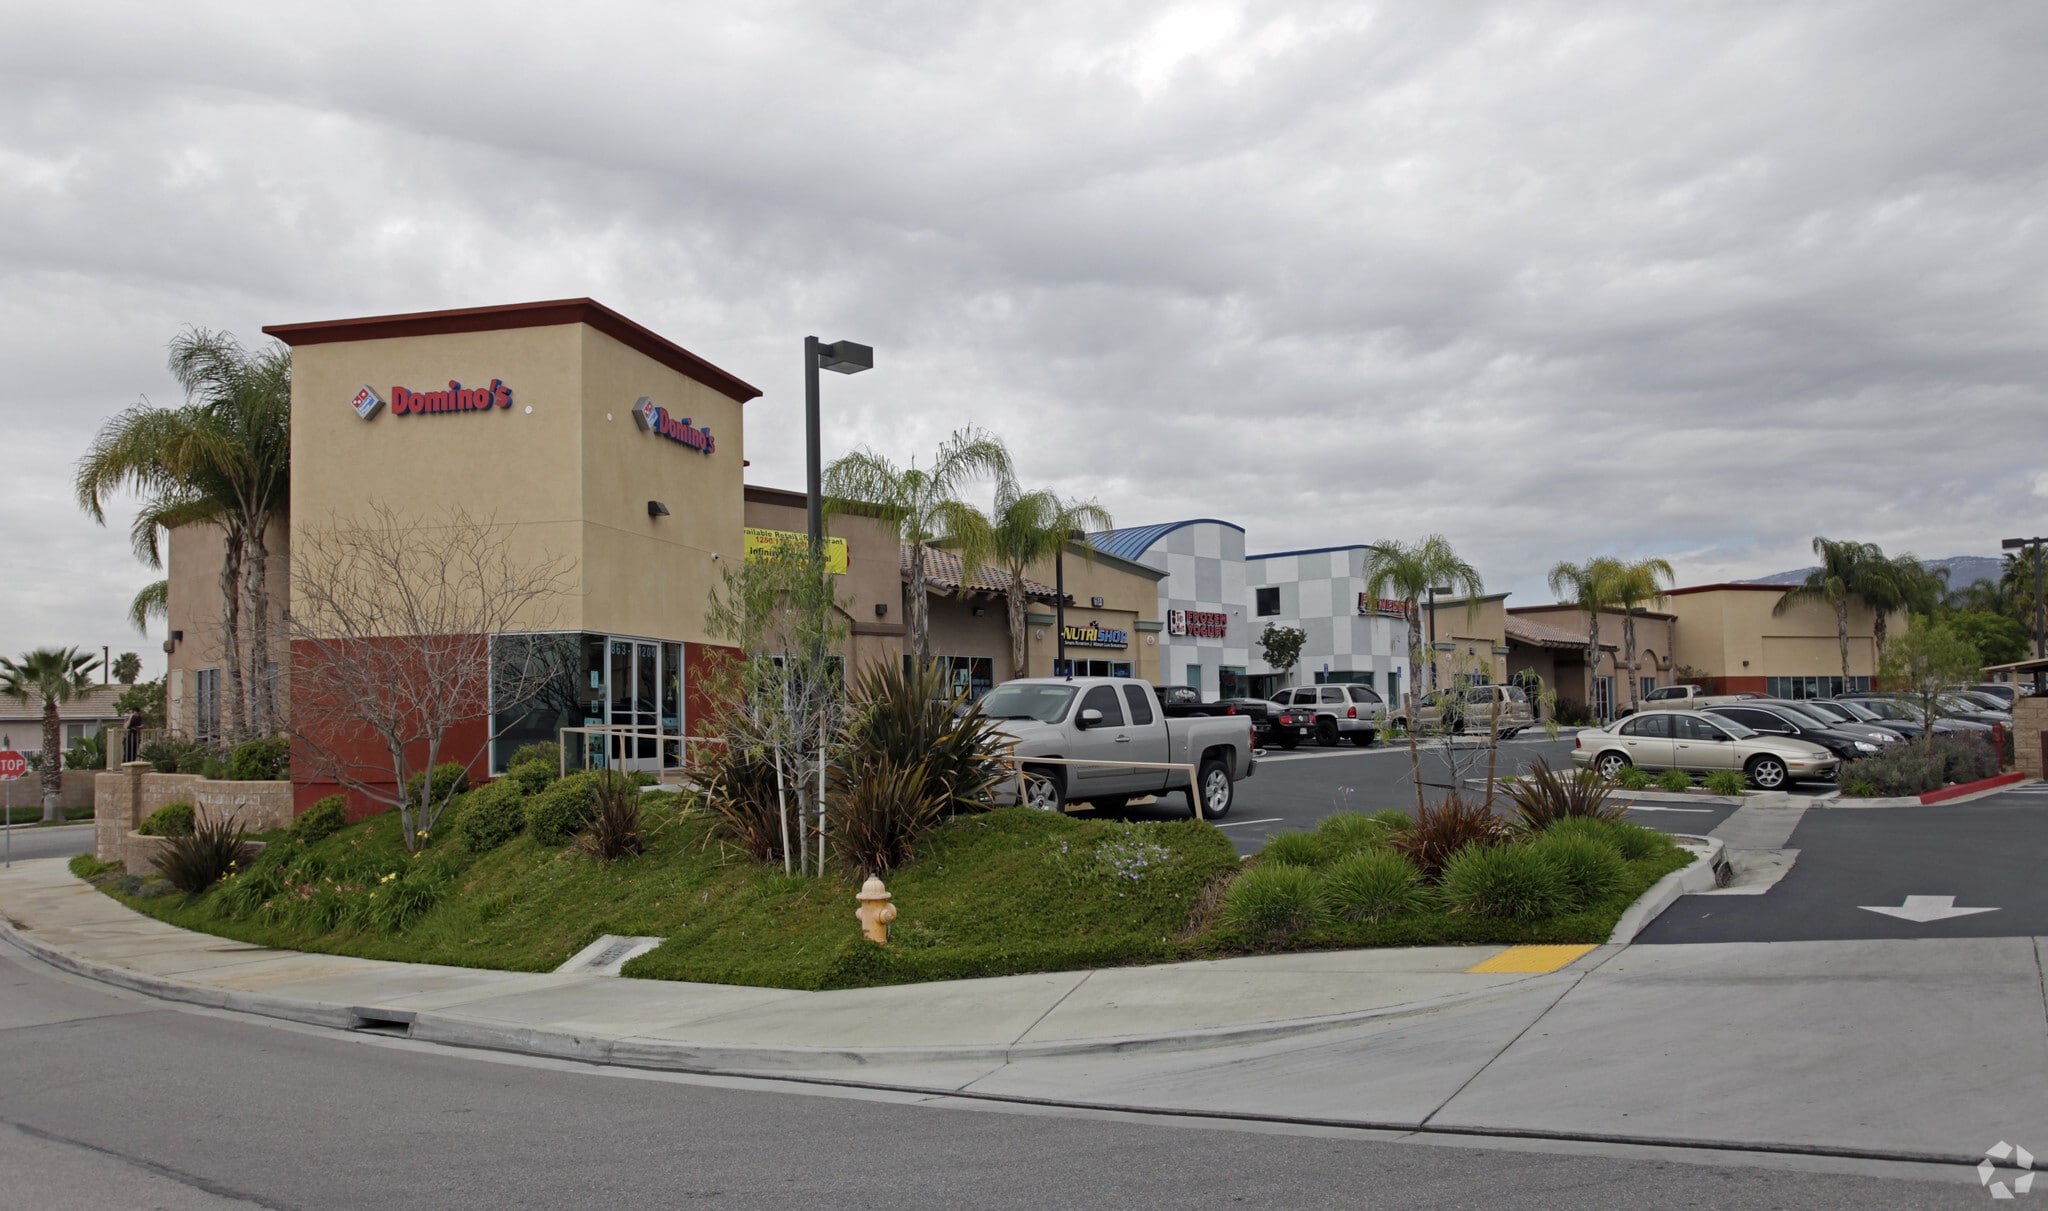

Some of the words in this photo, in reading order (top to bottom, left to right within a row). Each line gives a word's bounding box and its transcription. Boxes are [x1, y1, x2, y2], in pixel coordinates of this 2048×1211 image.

[392, 379, 513, 416] Domino's
[655, 406, 716, 454] Domino's
[744, 529, 772, 537] ailable
[1359, 592, 1405, 613] FTNESS
[1186, 610, 1228, 625] FROZEN
[1063, 626, 1129, 643] NUTRISHOP
[1187, 624, 1228, 637] YOGURT
[0, 759, 24, 771] TOP
